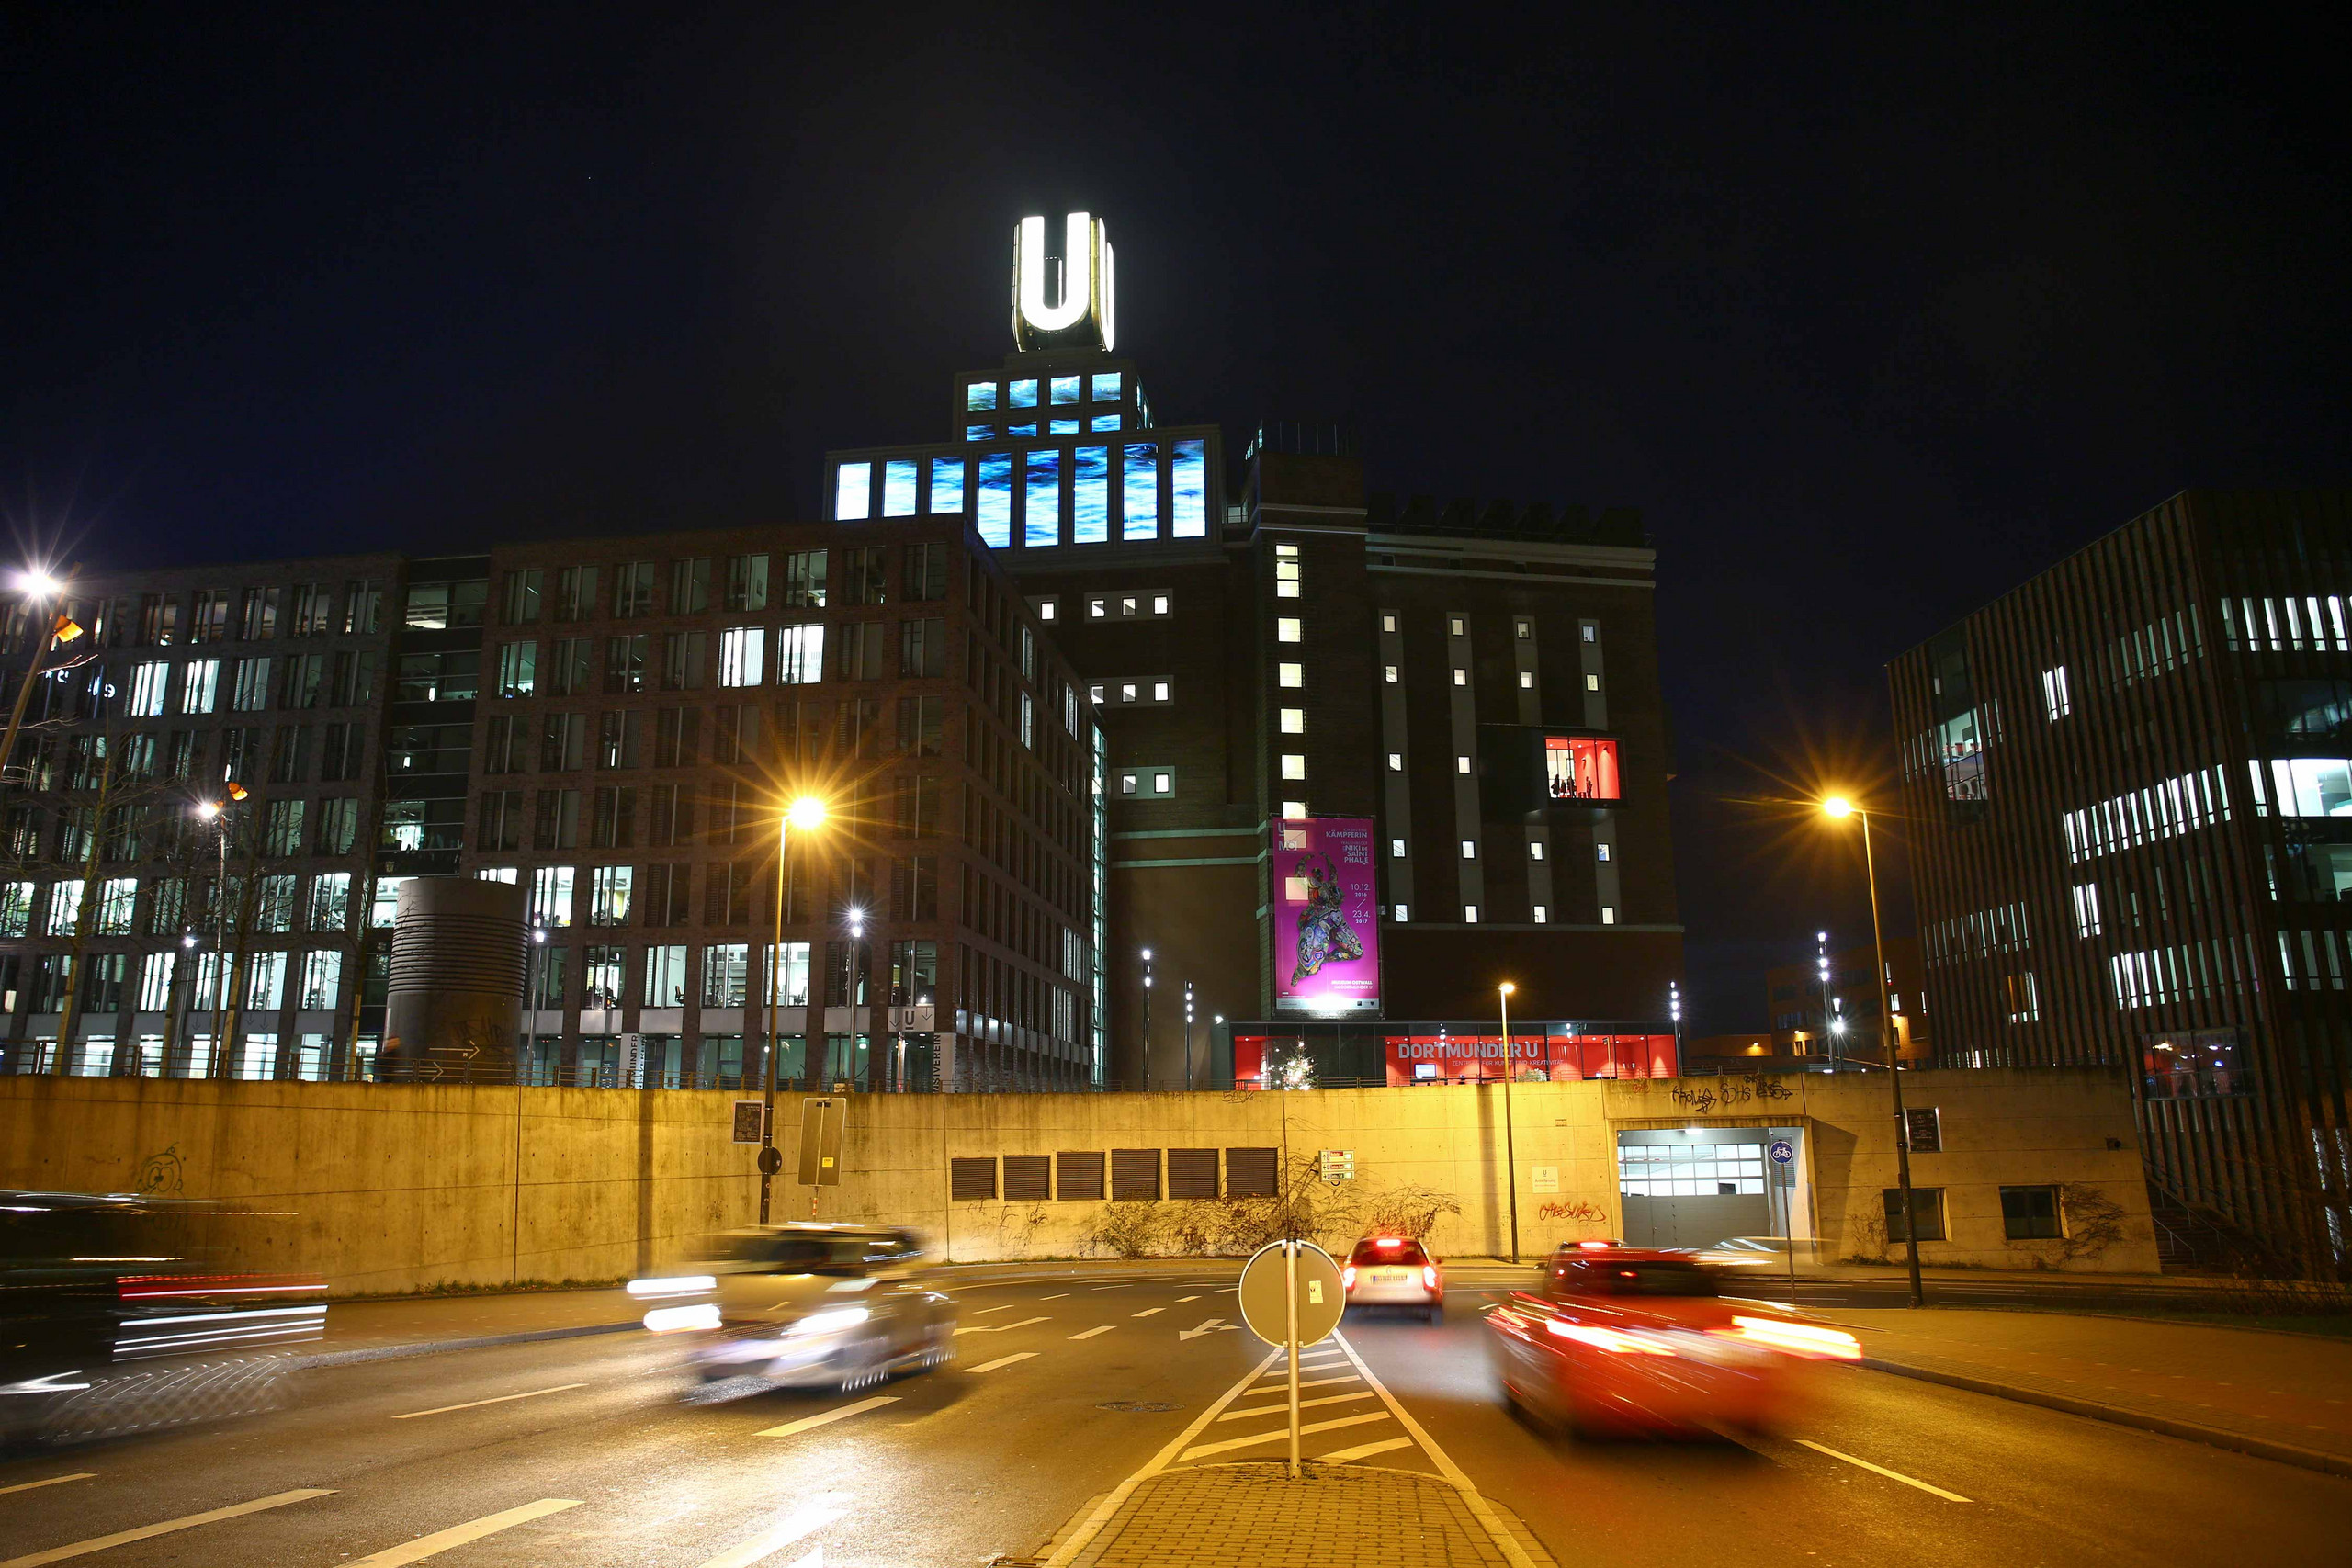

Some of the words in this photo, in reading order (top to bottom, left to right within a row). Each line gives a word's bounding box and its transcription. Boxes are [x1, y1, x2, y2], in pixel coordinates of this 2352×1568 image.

[1020, 211, 1091, 332] U
[1326, 829, 1368, 839] KÄMPFERIN
[1344, 856, 1369, 865] PHALLE
[1351, 883, 1370, 891] 10.12.
[1352, 910, 1370, 919] 23.4.
[905, 1010, 915, 1030] U
[1398, 1043, 1521, 1058] DORTMUNDER
[1526, 1043, 1538, 1058] U
